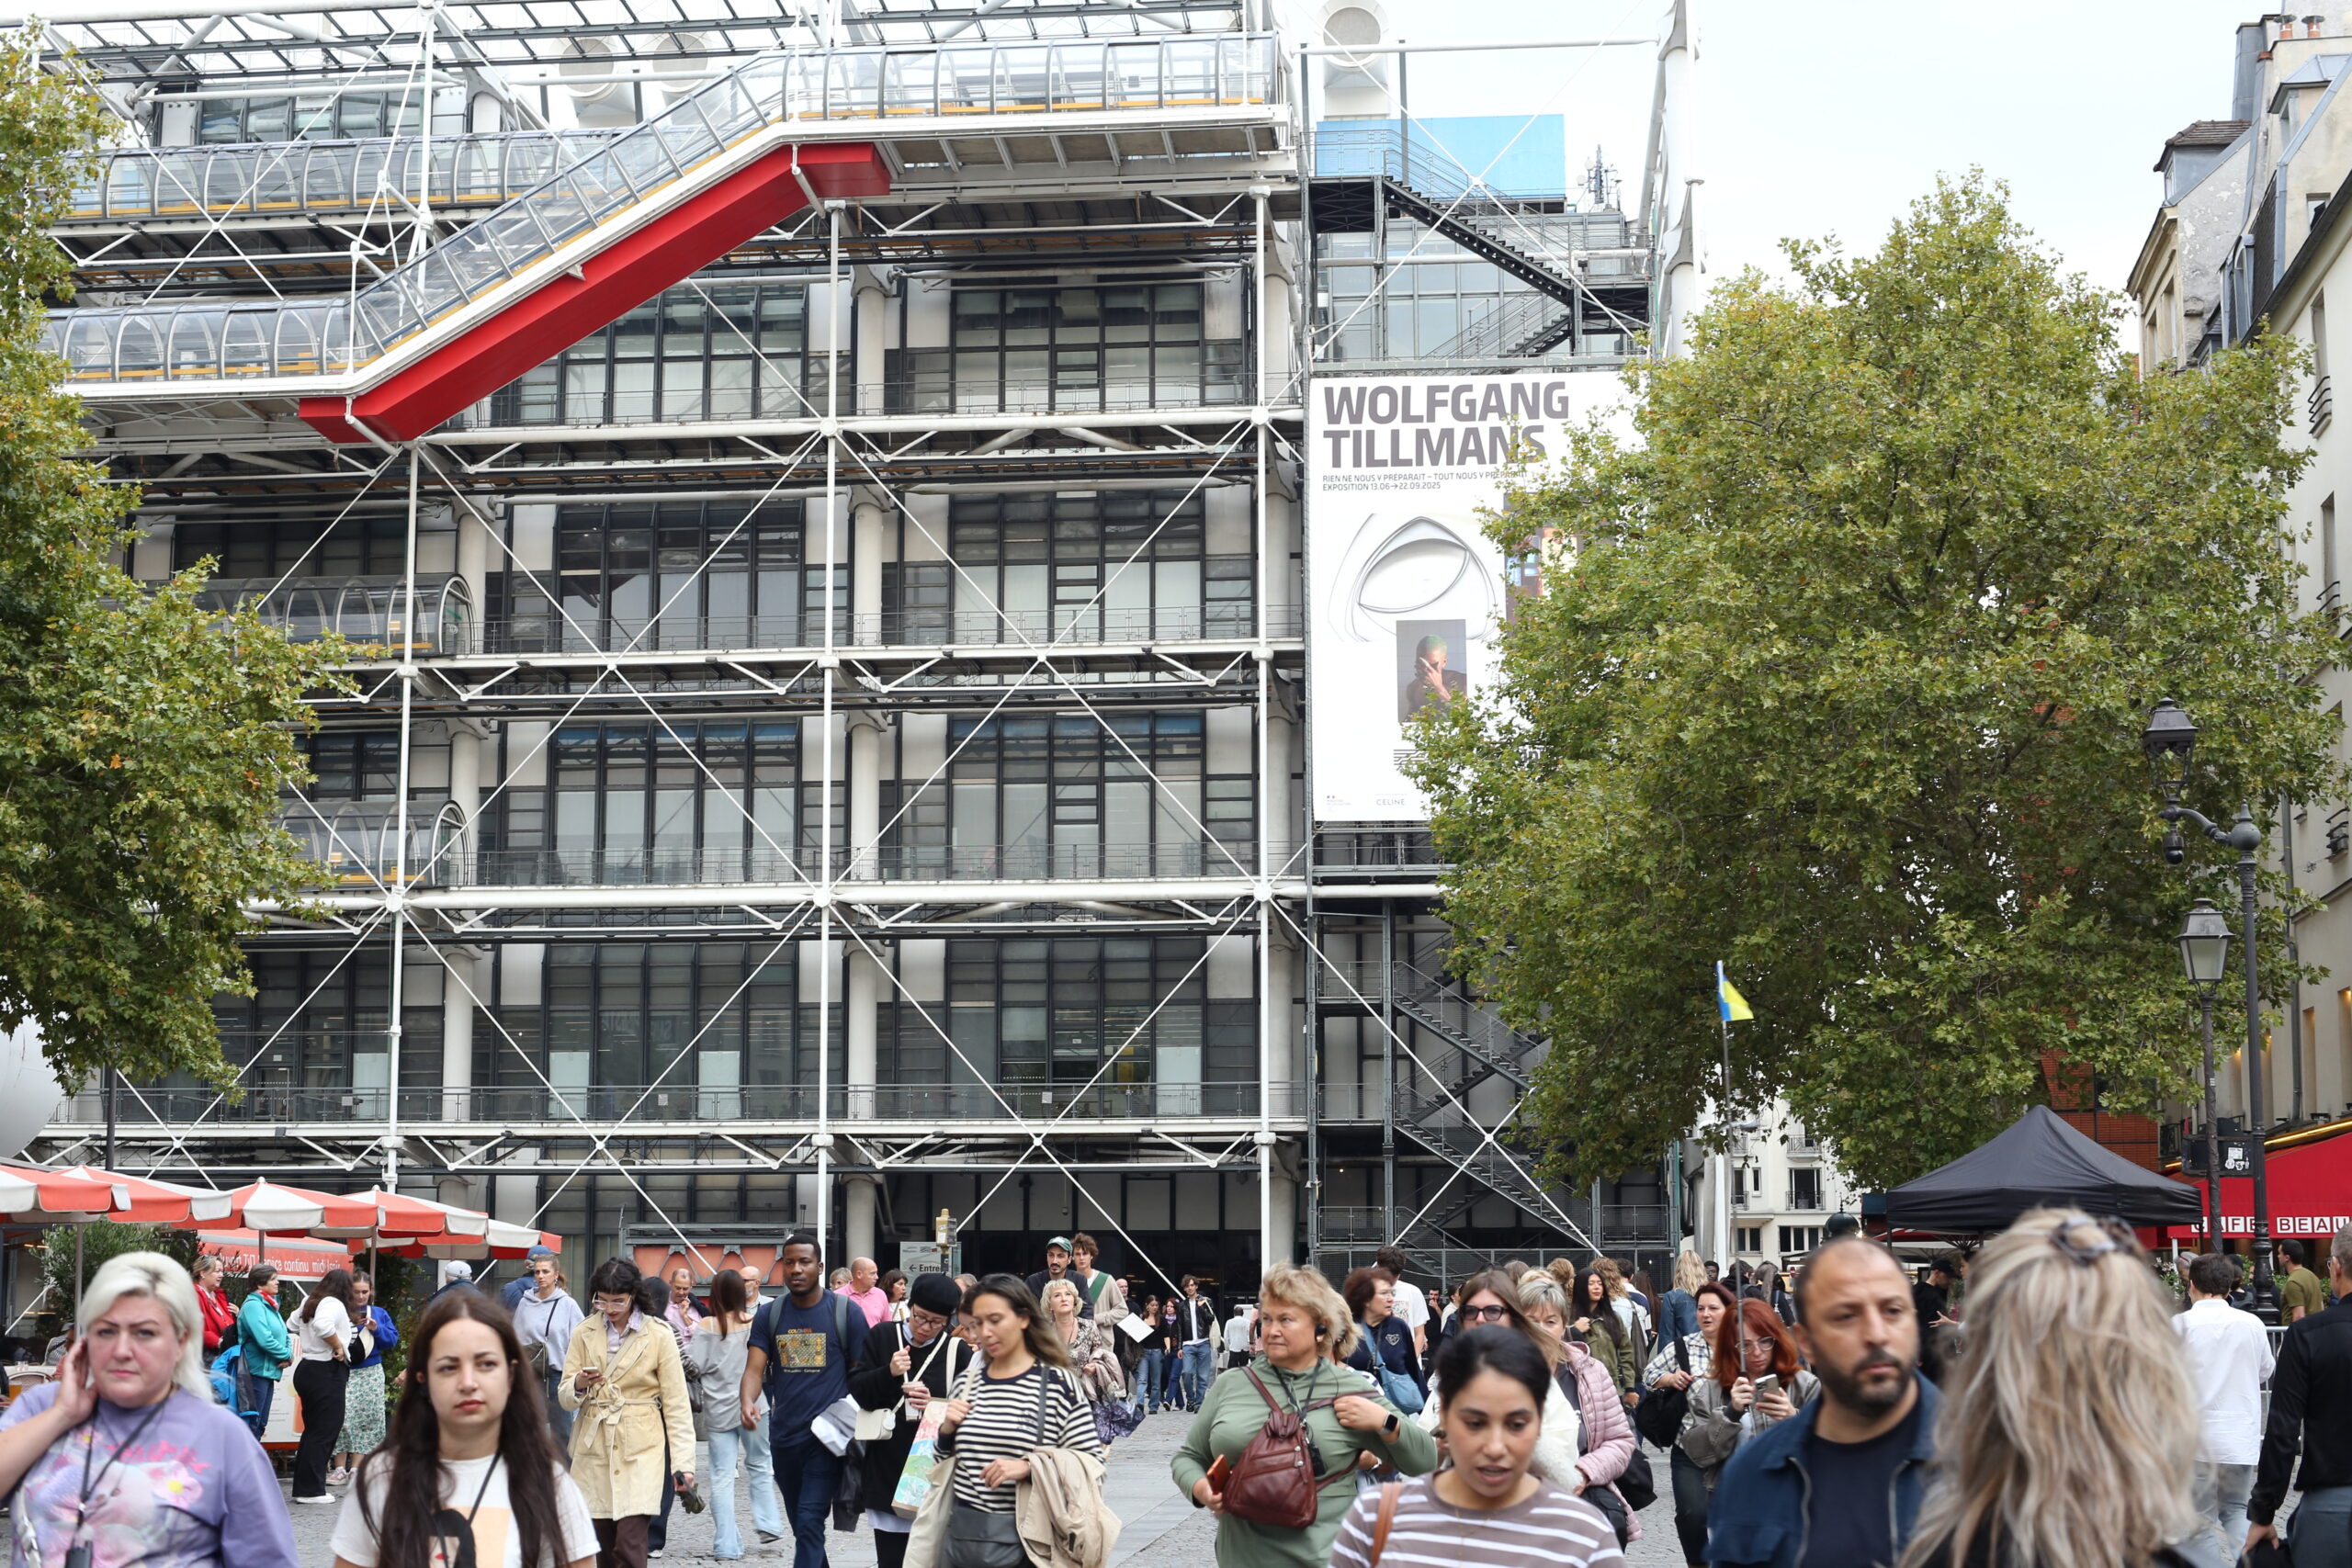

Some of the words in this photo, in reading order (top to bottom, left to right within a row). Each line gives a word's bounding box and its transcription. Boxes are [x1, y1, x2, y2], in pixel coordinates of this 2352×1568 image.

[1324, 381, 1568, 424] WOLFGANG
[1323, 425, 1545, 468] TILLMANS
[1384, 472, 1426, 480] PRÉPARAIT
[284, 1257, 309, 1273] continu
